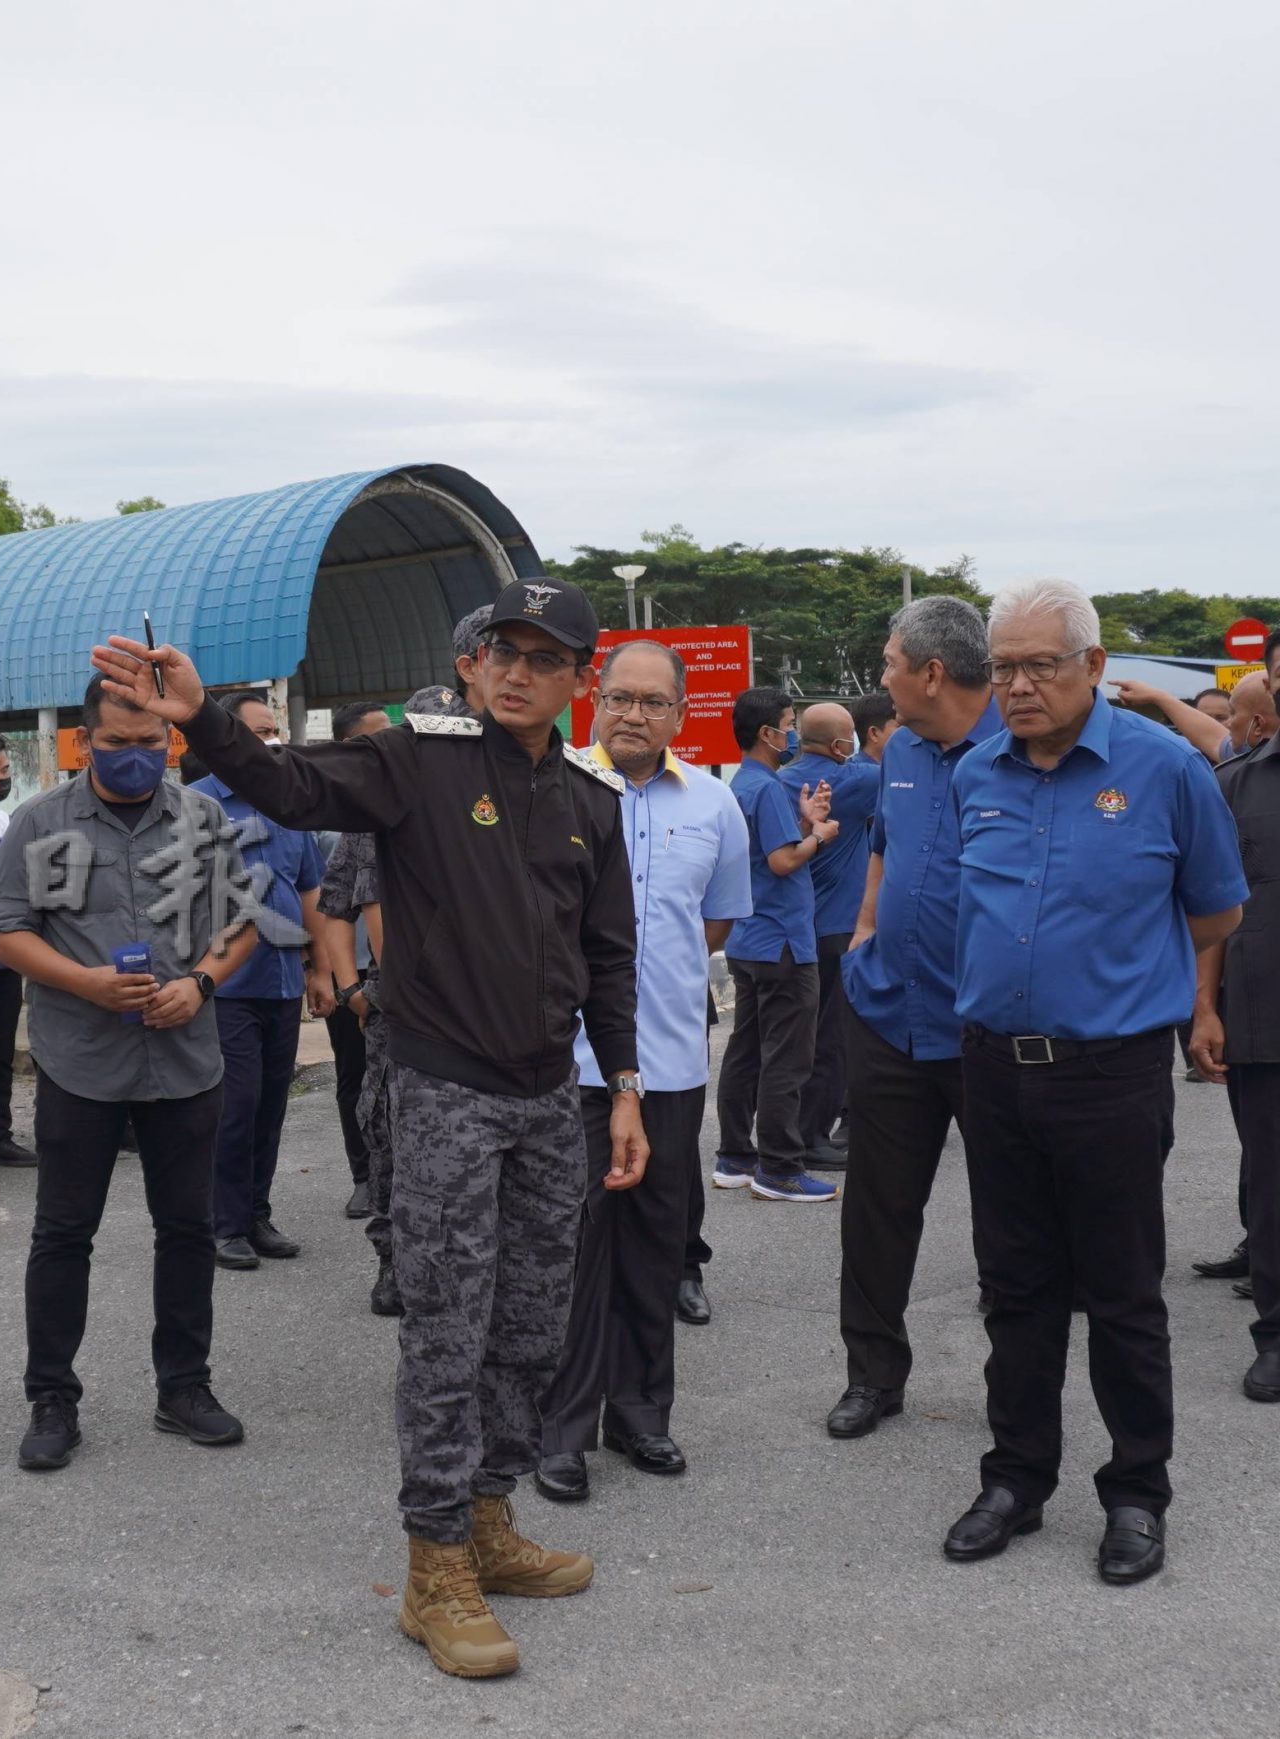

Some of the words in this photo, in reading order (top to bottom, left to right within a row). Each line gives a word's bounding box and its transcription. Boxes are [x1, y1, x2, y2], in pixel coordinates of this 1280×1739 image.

[671, 642, 715, 651] PROTECTED
[717, 641, 738, 649] AREA
[686, 664, 715, 672] TECTED
[716, 663, 741, 671] PLACE
[688, 701, 737, 709] NAUTHORISED
